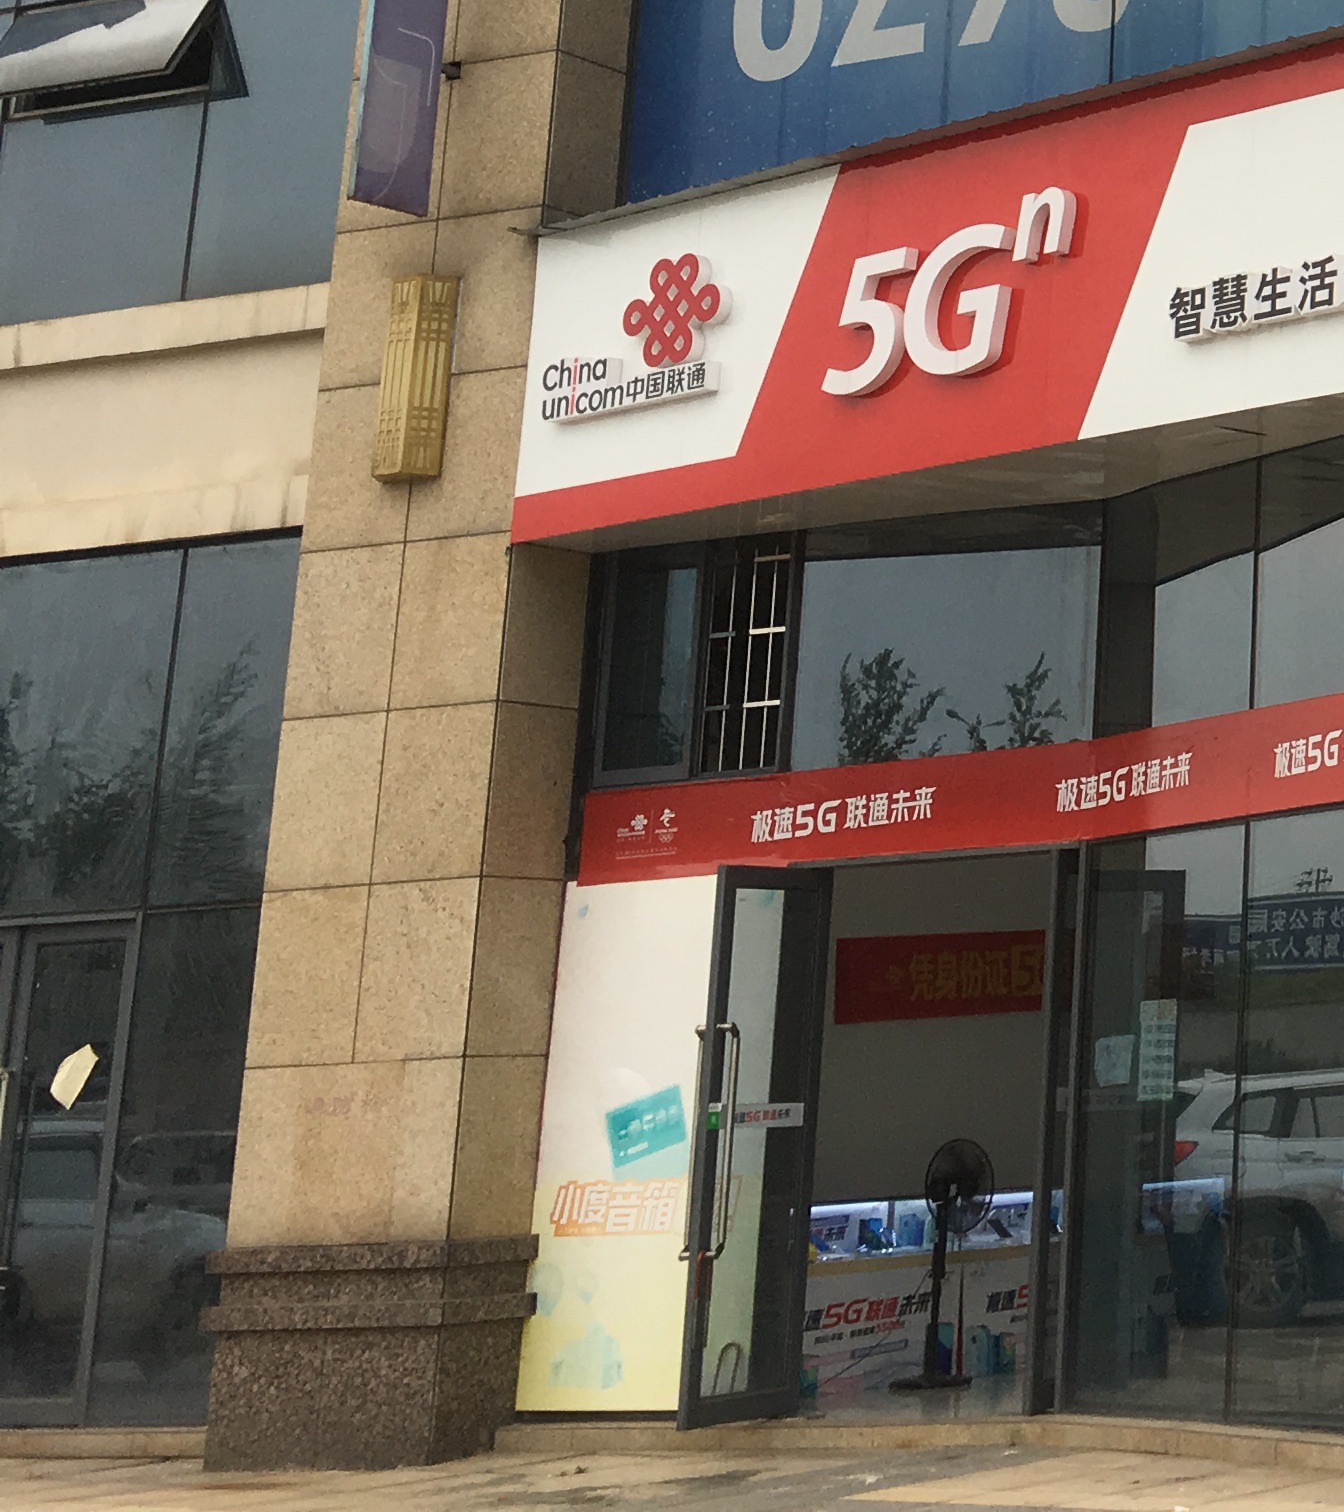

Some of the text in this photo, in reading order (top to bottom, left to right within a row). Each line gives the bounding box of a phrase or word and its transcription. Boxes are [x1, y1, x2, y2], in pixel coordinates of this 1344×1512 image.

[541, 361, 707, 422] unicom 中国联通
[542, 356, 609, 390] China
[552, 1181, 681, 1234] 小度音箱
